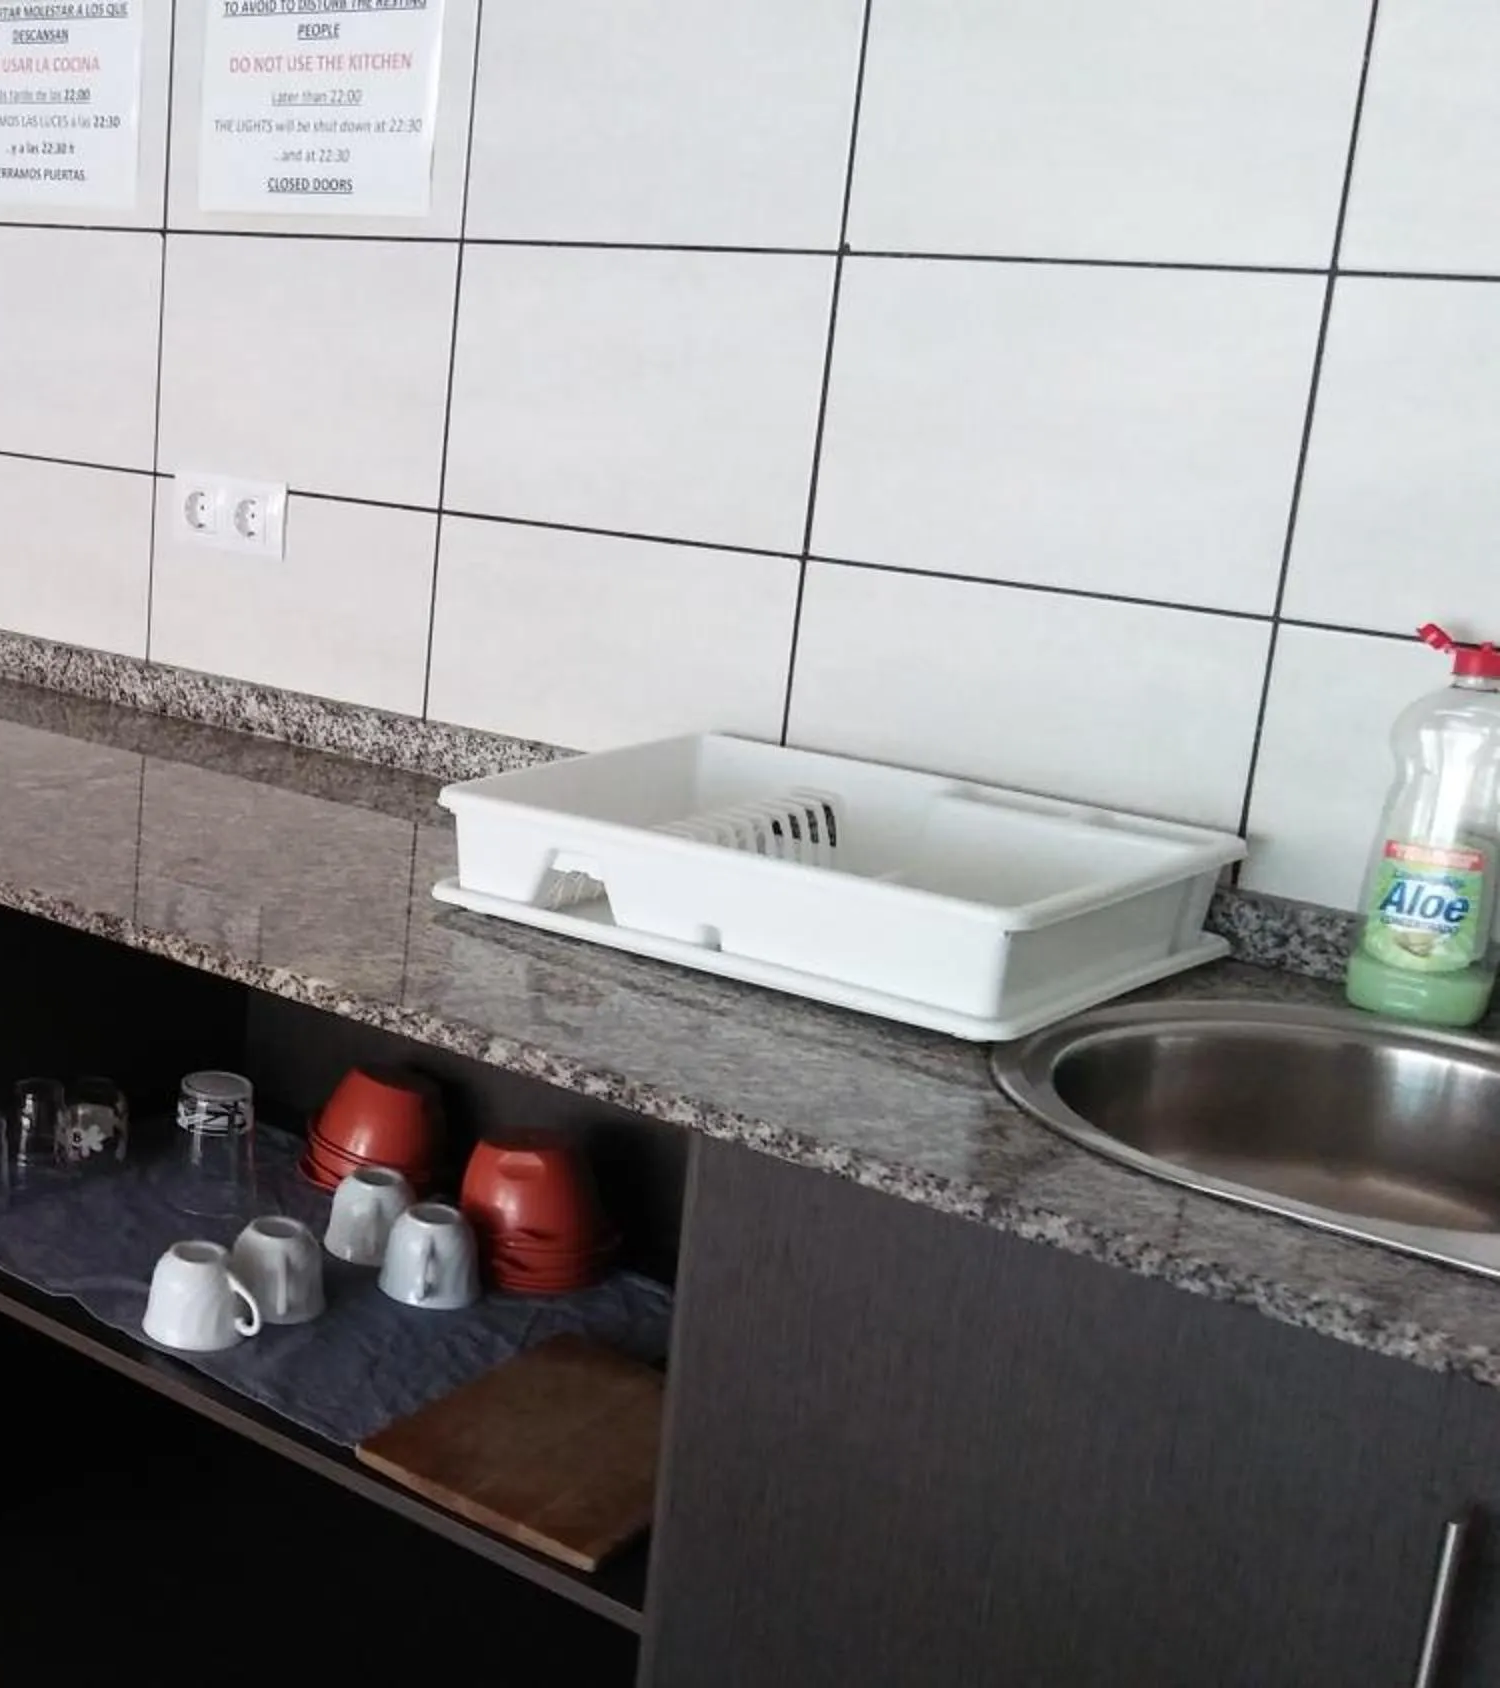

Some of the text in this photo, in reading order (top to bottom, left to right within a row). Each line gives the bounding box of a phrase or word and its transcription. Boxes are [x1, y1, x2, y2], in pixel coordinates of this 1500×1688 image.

[23, 5, 75, 18] MOLESTAR
[86, 4, 104, 17] LOS
[106, 2, 129, 16] QUE
[225, 2, 238, 14] TO
[241, 1, 277, 13] AVOID
[281, 0, 295, 12] TO
[12, 29, 69, 43] DESCANSAN
[297, 23, 340, 38] PEOPLE
[3, 57, 33, 72] USAR
[36, 57, 50, 73] LA
[52, 56, 100, 72] COCINA
[229, 52, 413, 73] DO NOT USE THE KITCHEN
[35, 89, 47, 101] de
[64, 88, 91, 101] 22:00
[272, 90, 363, 104] Later than 22:00
[93, 114, 121, 129] 22:30
[214, 118, 423, 134] THE LIGHTS will be shut down at 22:30
[305, 149, 316, 163] at
[318, 148, 351, 163] 22:30
[43, 168, 86, 182] PUERTAS
[267, 177, 354, 193] CLOSED DOORS
[1378, 881, 1470, 922] Aloe
